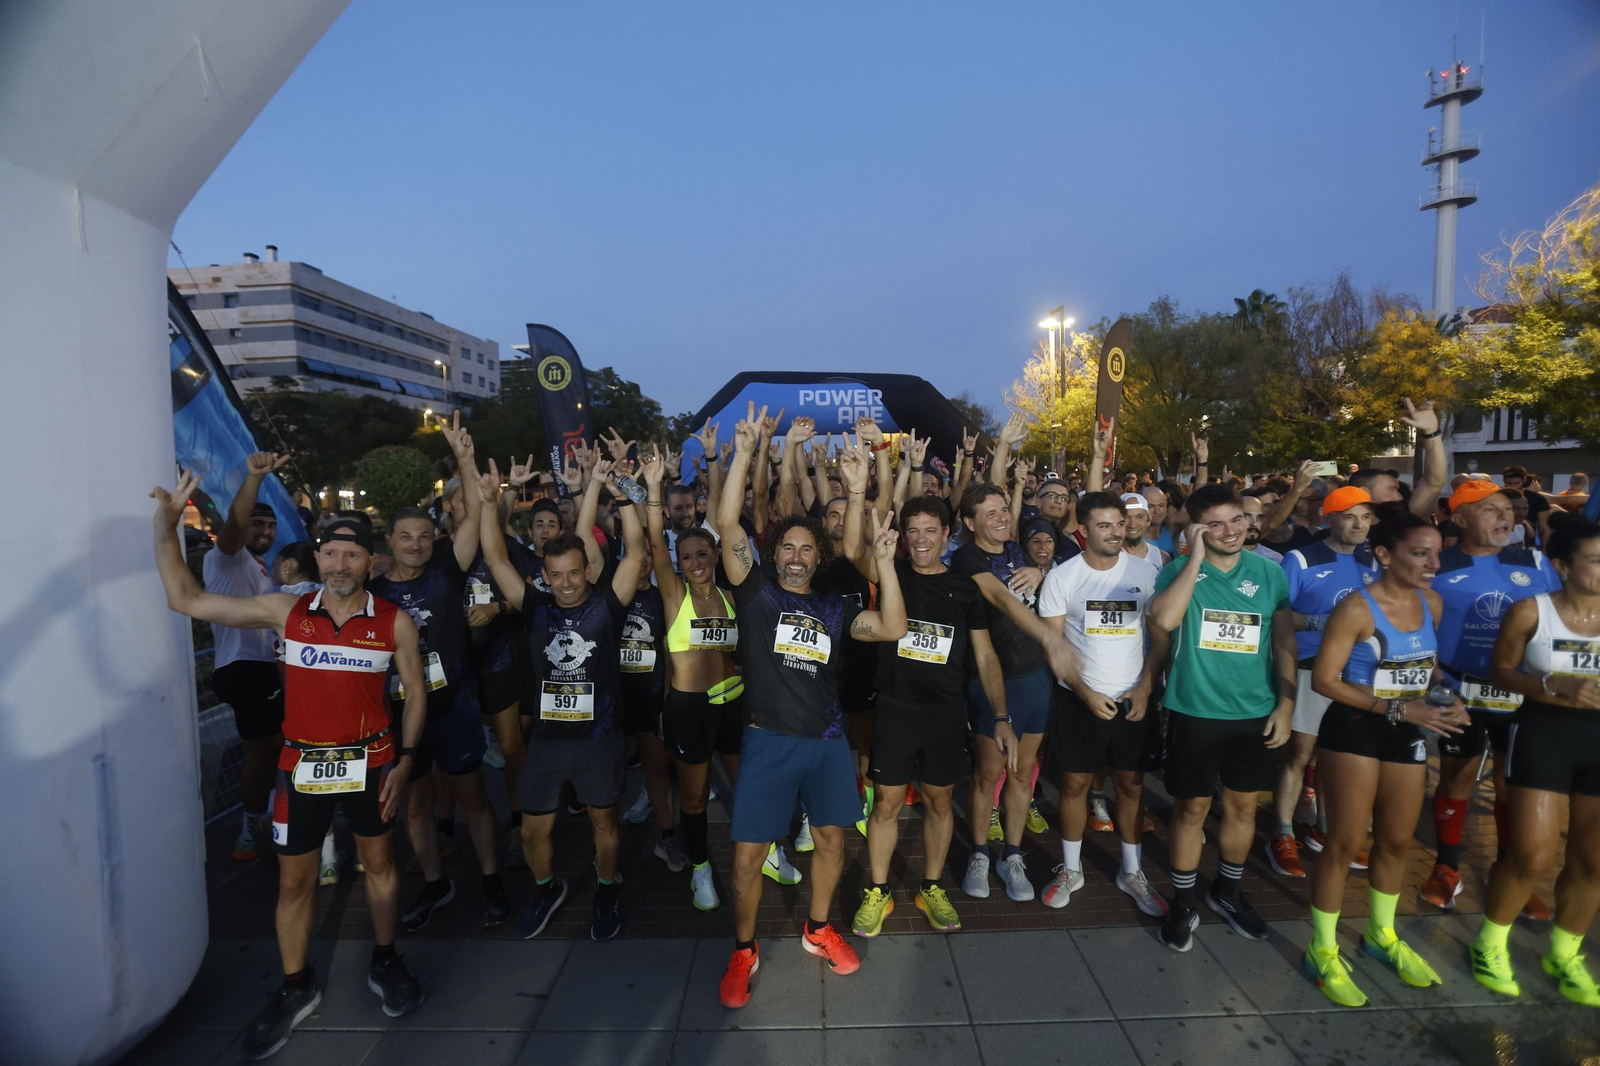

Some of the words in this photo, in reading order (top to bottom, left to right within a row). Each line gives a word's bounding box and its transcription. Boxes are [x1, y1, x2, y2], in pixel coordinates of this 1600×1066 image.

[799, 389, 883, 406] POWER
[838, 406, 884, 424] ADE
[1101, 611, 1123, 625] 341
[702, 628, 728, 641] 1491
[791, 627, 819, 646] 204
[1218, 624, 1246, 639] 342
[352, 638, 387, 648] FRANCISCO
[912, 633, 939, 650] 358
[318, 651, 373, 668] Avanza
[621, 649, 643, 662] 180
[1389, 669, 1428, 685] 1523
[1480, 685, 1511, 699] 804
[554, 694, 578, 709] 597
[313, 761, 348, 780] 606
